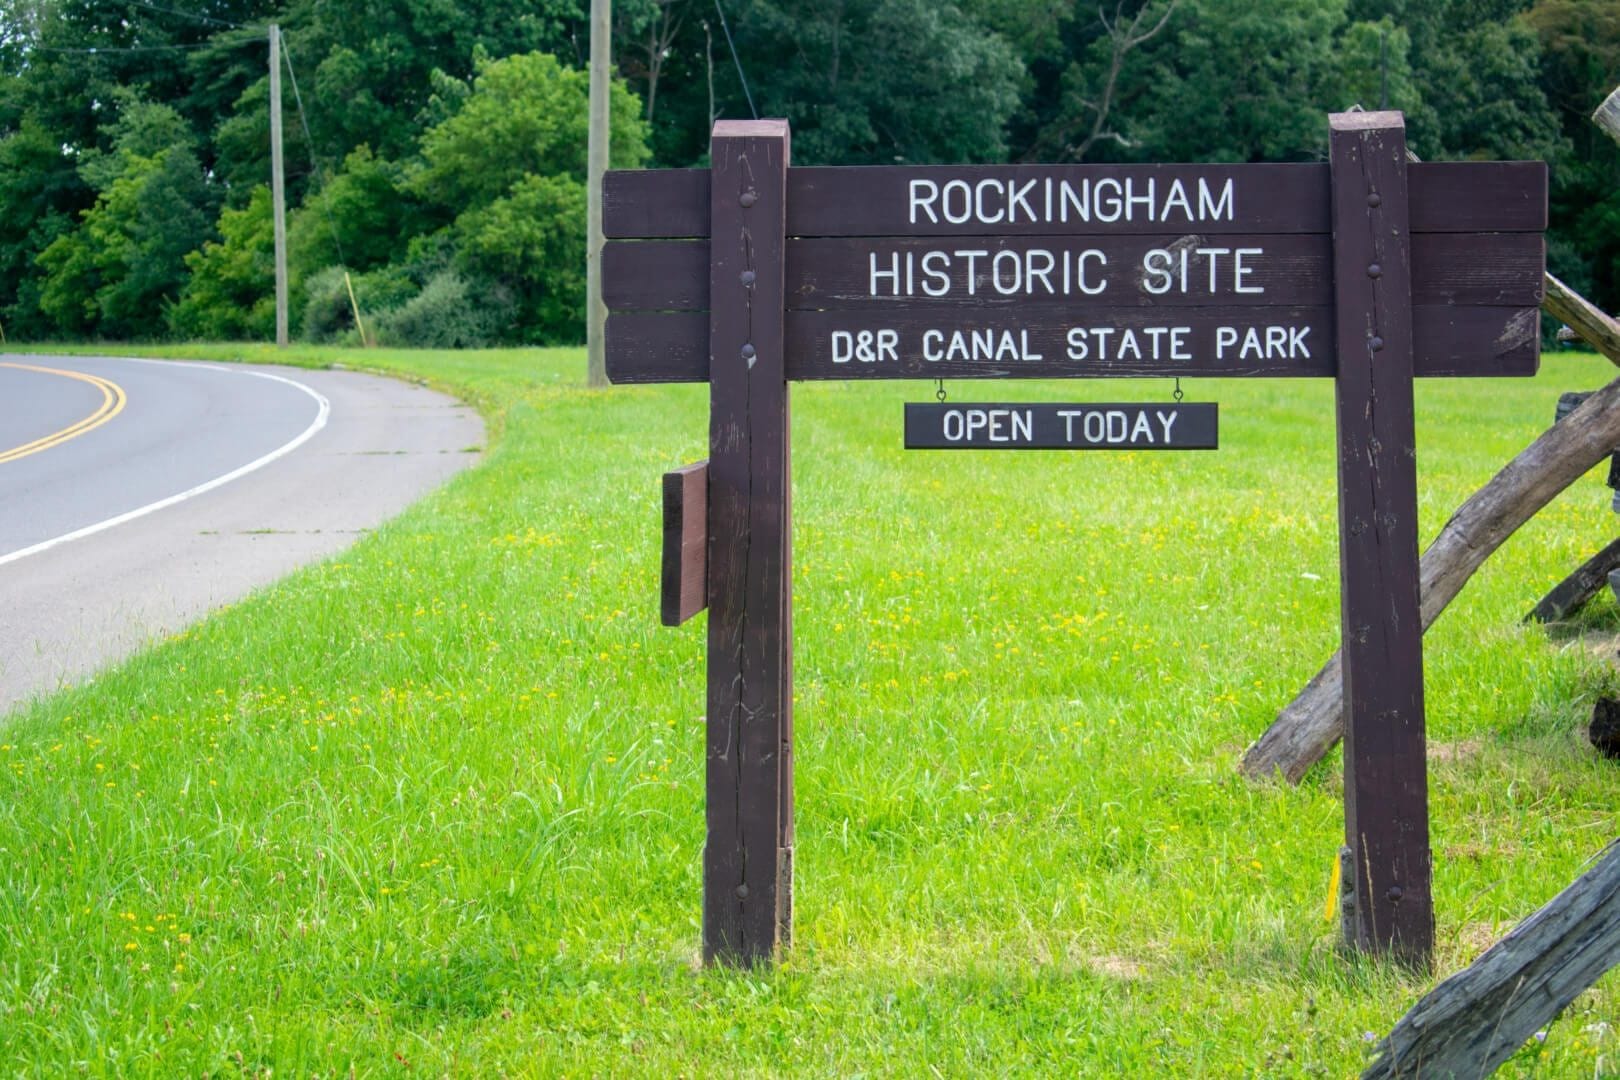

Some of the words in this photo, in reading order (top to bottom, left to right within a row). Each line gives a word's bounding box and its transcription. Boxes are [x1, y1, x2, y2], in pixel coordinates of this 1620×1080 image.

[909, 177, 1235, 224] ROCKINGHAM
[869, 249, 1107, 297] HISTORIC
[1143, 247, 1265, 295] SITE
[831, 328, 899, 363] D&R
[922, 328, 1043, 362] CANAL
[1066, 326, 1193, 360] STATE
[1216, 326, 1311, 360] PARK
[942, 409, 1033, 442] OPEN
[1056, 410, 1178, 443] TODAY
